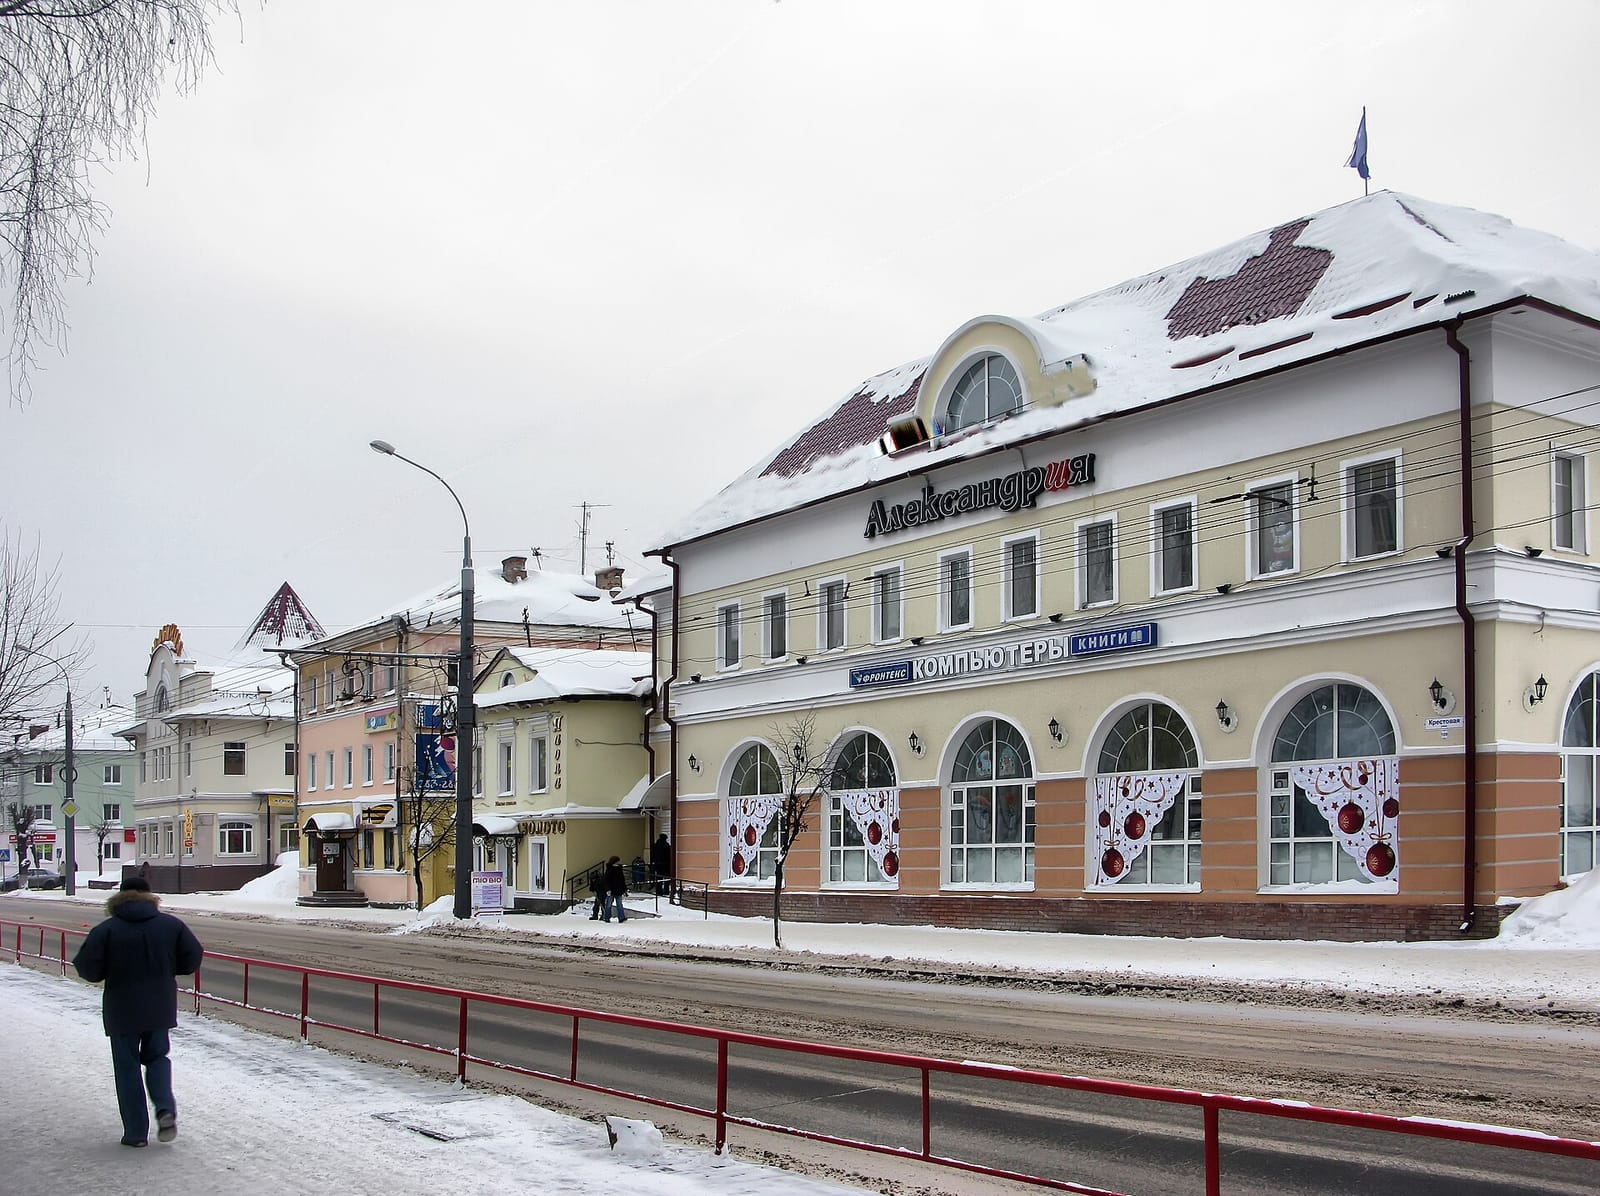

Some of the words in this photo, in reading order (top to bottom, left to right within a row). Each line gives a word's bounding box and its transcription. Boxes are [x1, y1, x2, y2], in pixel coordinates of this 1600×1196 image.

[863, 453, 1096, 538] Александрия
[1077, 632, 1129, 651] КНИГИ
[911, 636, 1071, 680] КОМПЬЮТЕРЫ
[862, 669, 907, 683] ФРОНТЕКС
[1428, 718, 1460, 726] Крестовая
